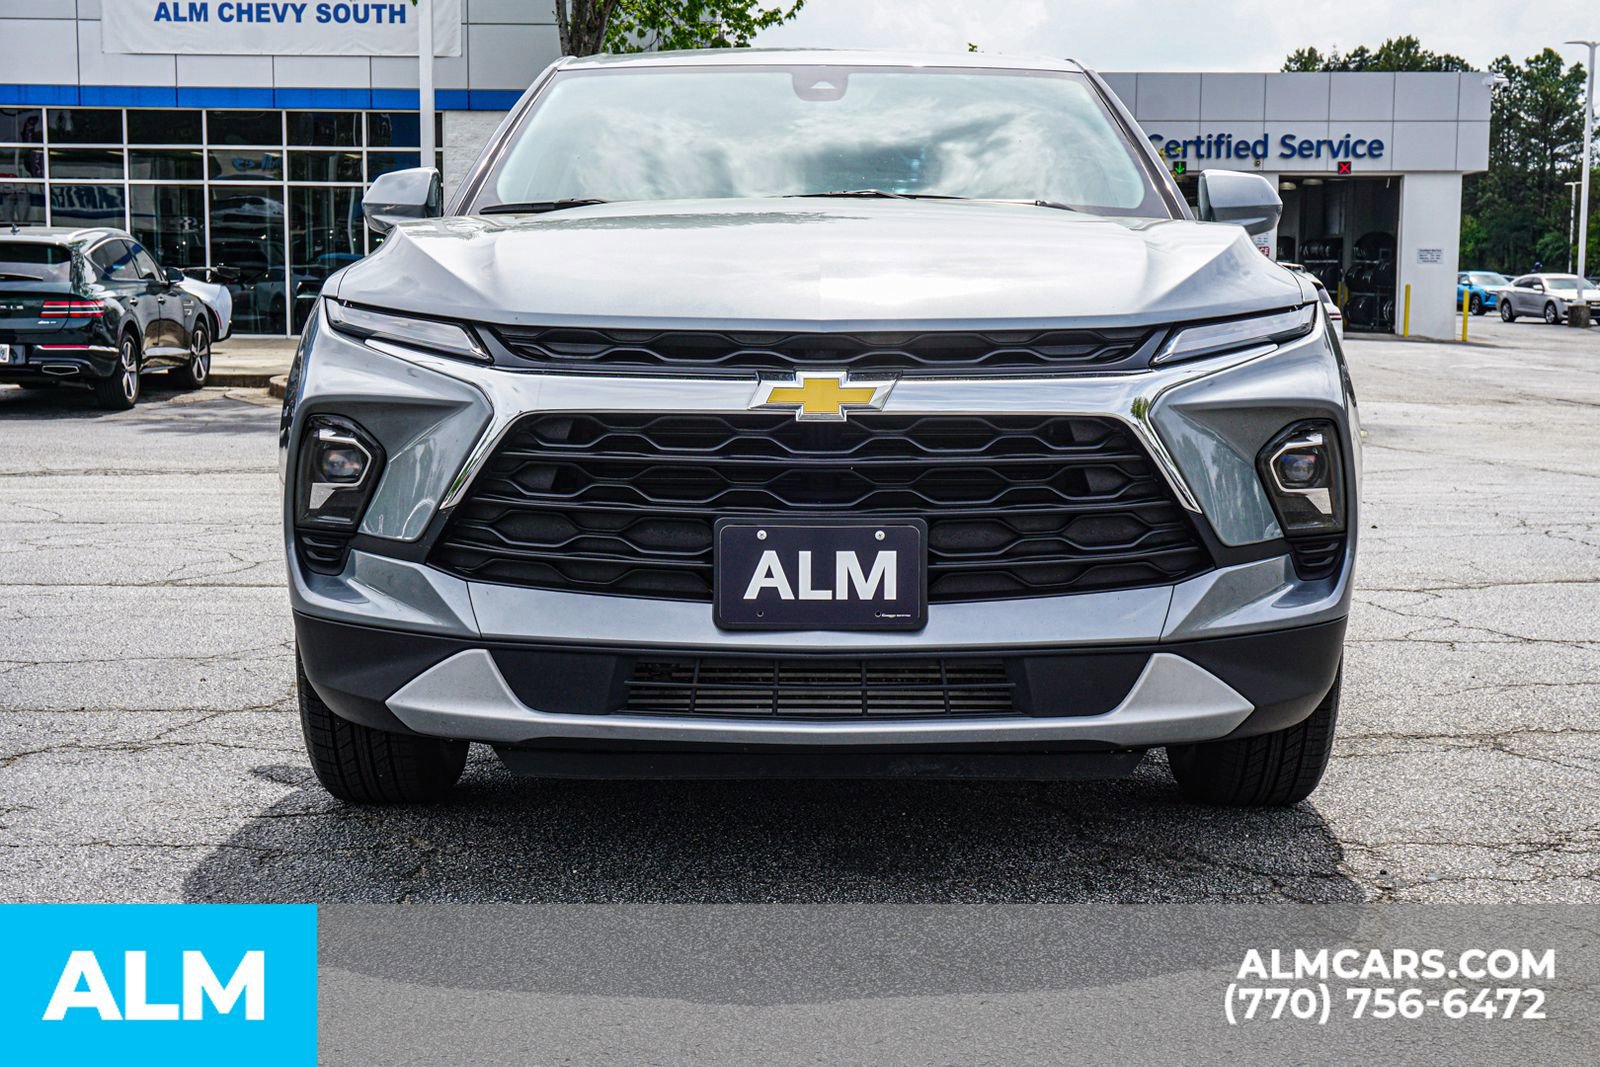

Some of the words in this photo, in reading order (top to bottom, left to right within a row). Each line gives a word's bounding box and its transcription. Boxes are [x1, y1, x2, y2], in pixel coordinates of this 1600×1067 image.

[153, 1, 210, 23] ALM
[217, 1, 308, 24] CHEVY
[315, 2, 407, 25] SOUTH
[1279, 133, 1385, 160] Service
[743, 550, 897, 600] ALM
